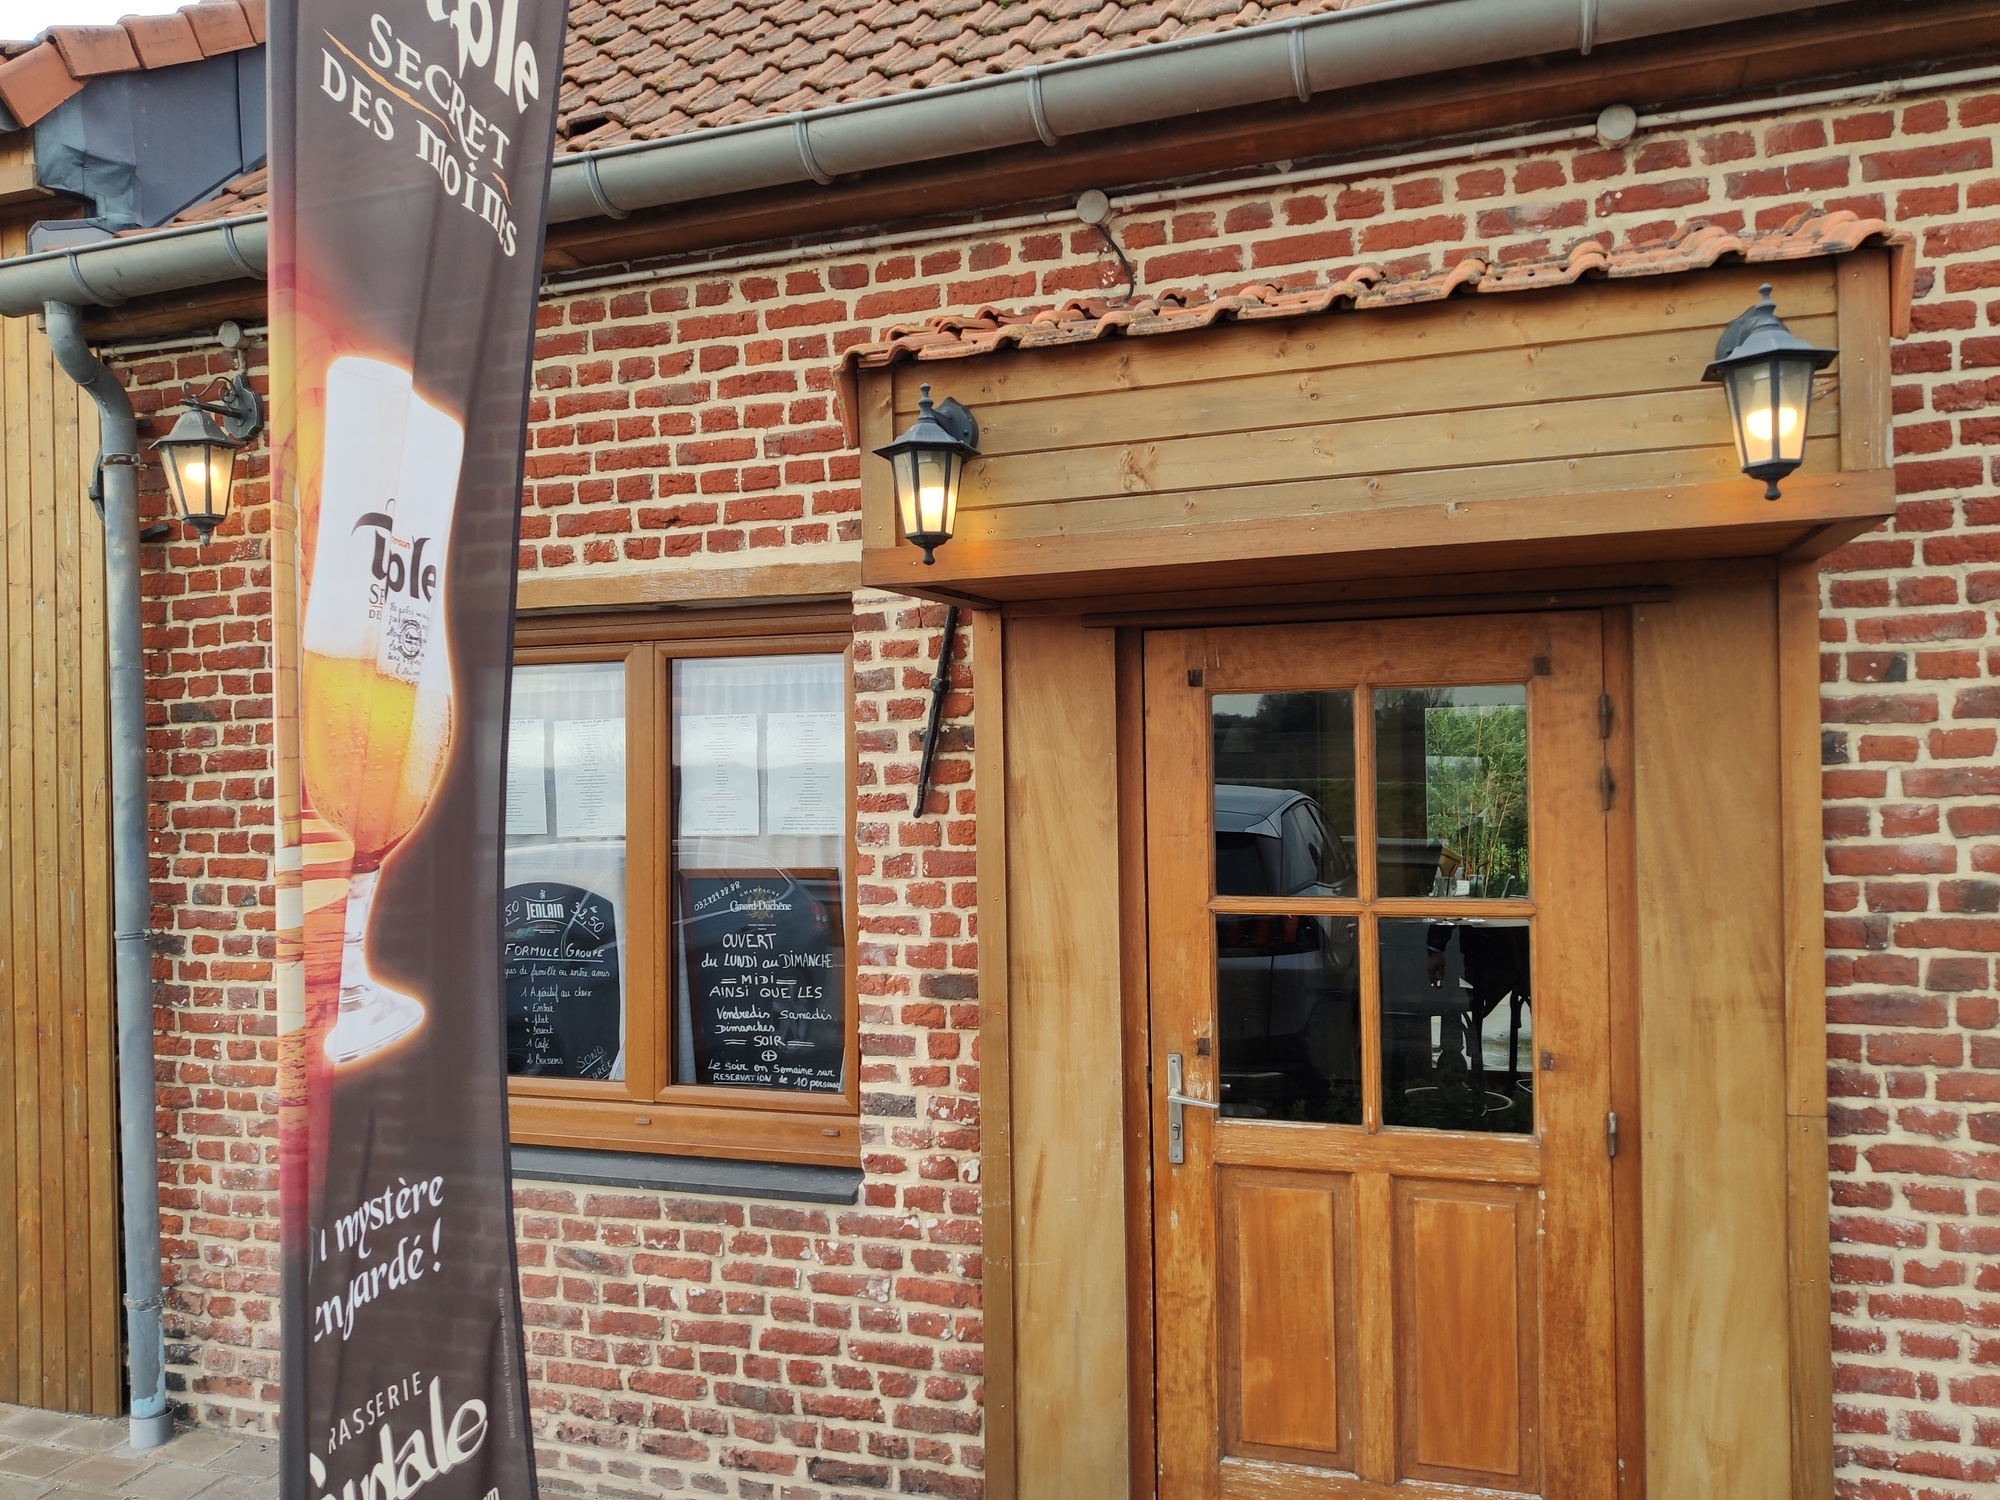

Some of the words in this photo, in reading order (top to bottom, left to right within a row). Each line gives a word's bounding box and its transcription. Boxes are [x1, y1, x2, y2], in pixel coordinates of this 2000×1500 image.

[320, 47, 395, 141] DES
[368, 13, 511, 170] SECRET
[740, 888, 780, 897] CHAMPAGNE
[526, 901, 565, 920] JENLAIN
[730, 900, 792, 912] Canard-Duchêne
[722, 932, 777, 950] OUVERT
[701, 952, 719, 968] du
[762, 961, 780, 969] au
[530, 963, 558, 983] famille
[591, 969, 610, 978] amis
[574, 986, 593, 998] choix
[760, 987, 792, 999] QUE
[797, 986, 823, 999] LES
[716, 1004, 771, 1020] Vendredis
[753, 1035, 787, 1047] SOIR
[576, 1045, 604, 1069] SONO
[707, 1059, 721, 1070] Le
[724, 1060, 749, 1071] soir
[793, 1077, 808, 1087] 10
[335, 1176, 444, 1259] mystère
[328, 1371, 423, 1455] RASSERIE
